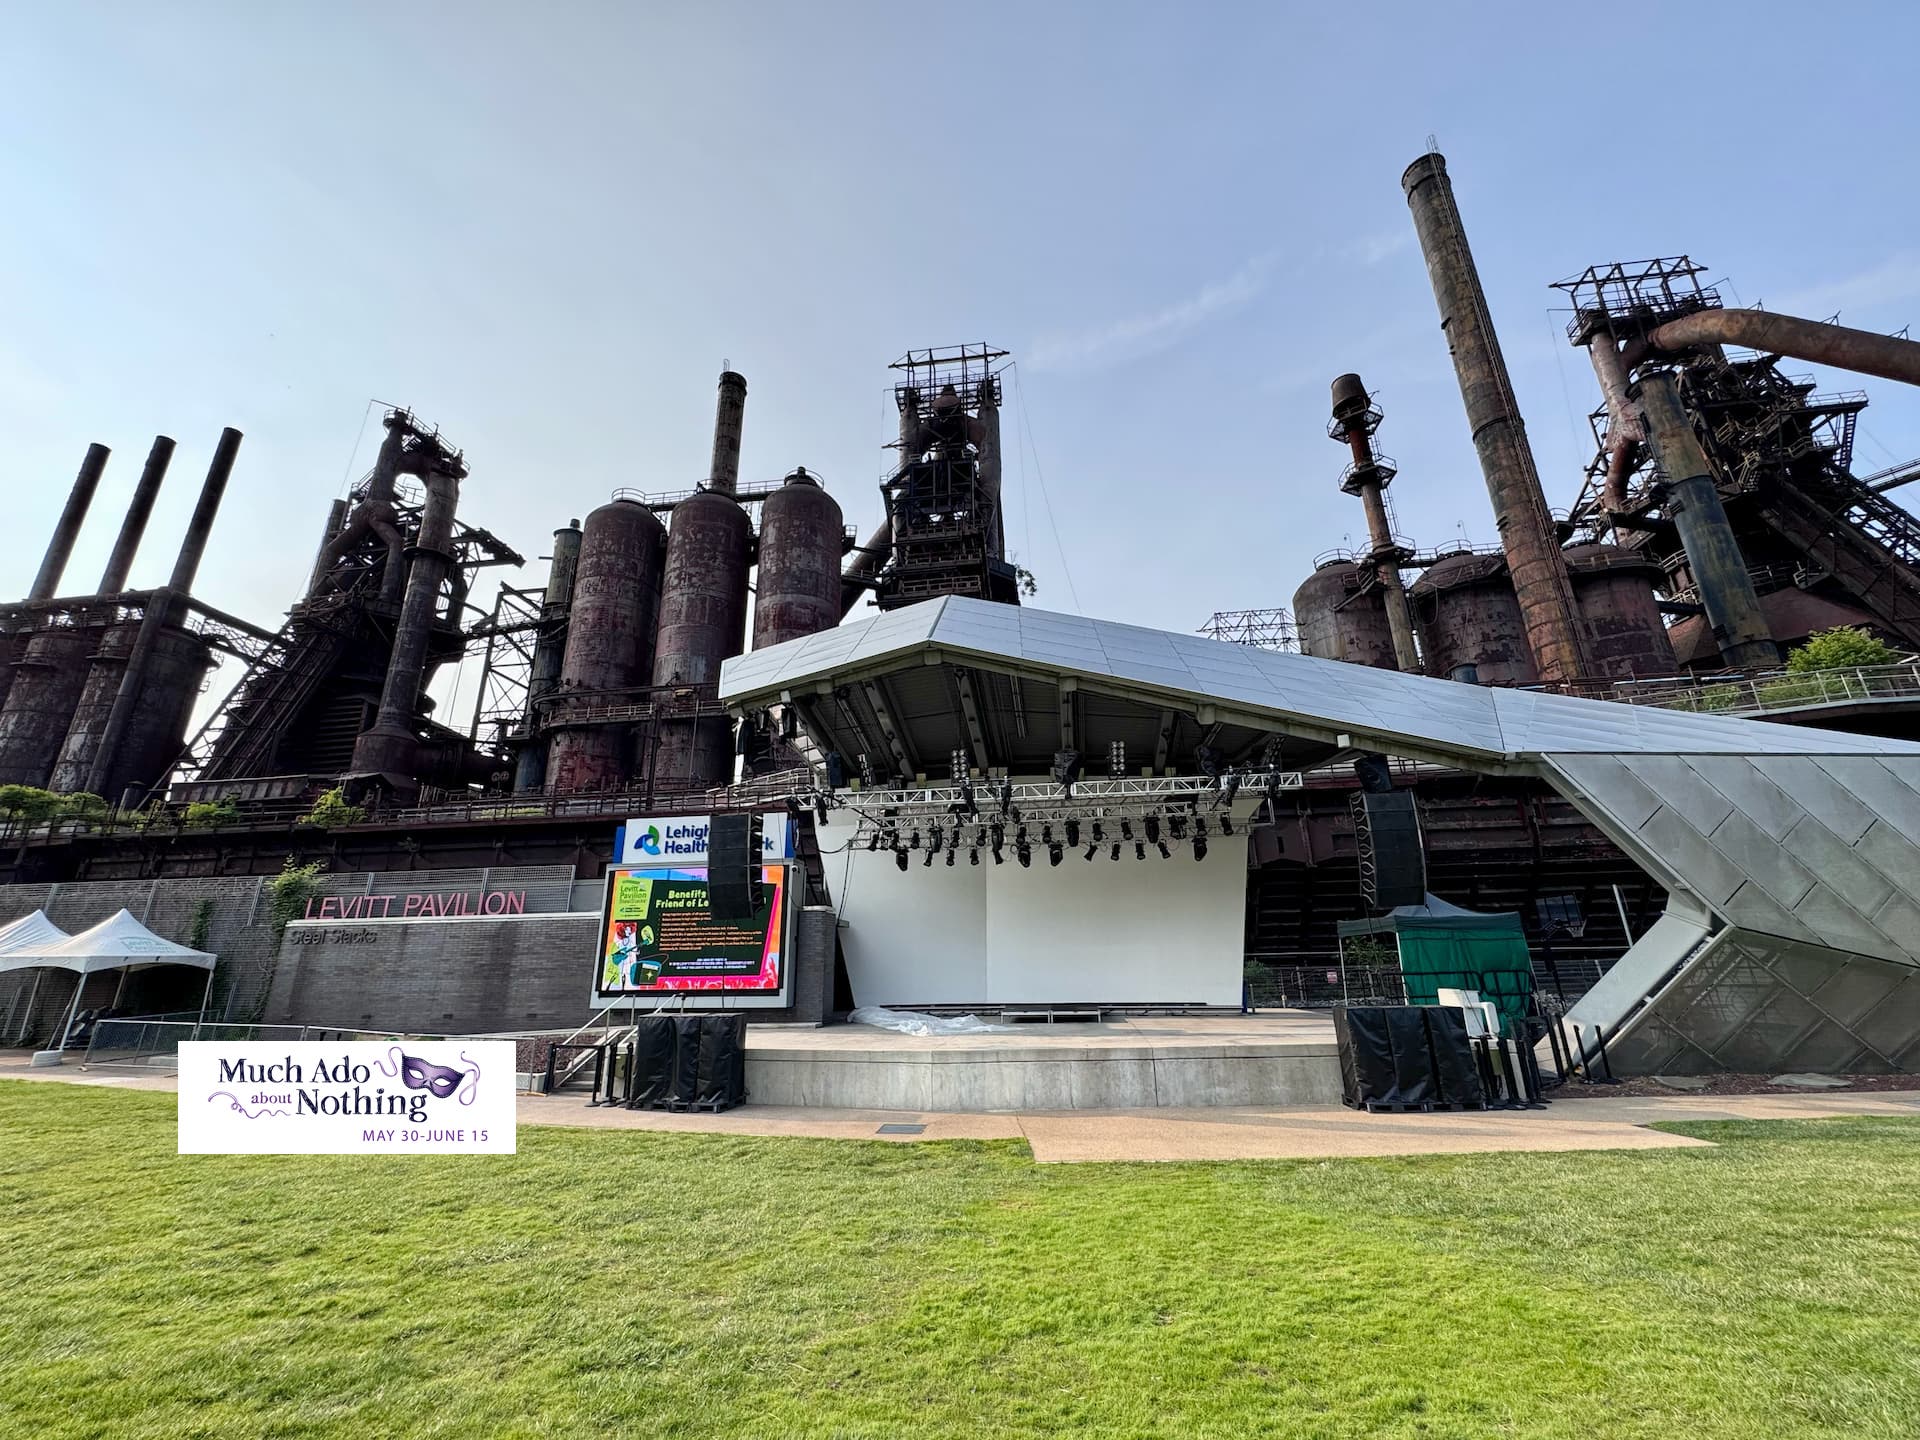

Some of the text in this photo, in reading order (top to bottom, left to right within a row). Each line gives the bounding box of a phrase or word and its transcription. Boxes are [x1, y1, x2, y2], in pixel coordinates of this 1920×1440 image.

[668, 889, 707, 899] Benefits
[305, 890, 527, 920] LEVITT PAVILION
[655, 899, 685, 908] Friend
[686, 899, 697, 907] of
[289, 929, 377, 945] Steel Stacks
